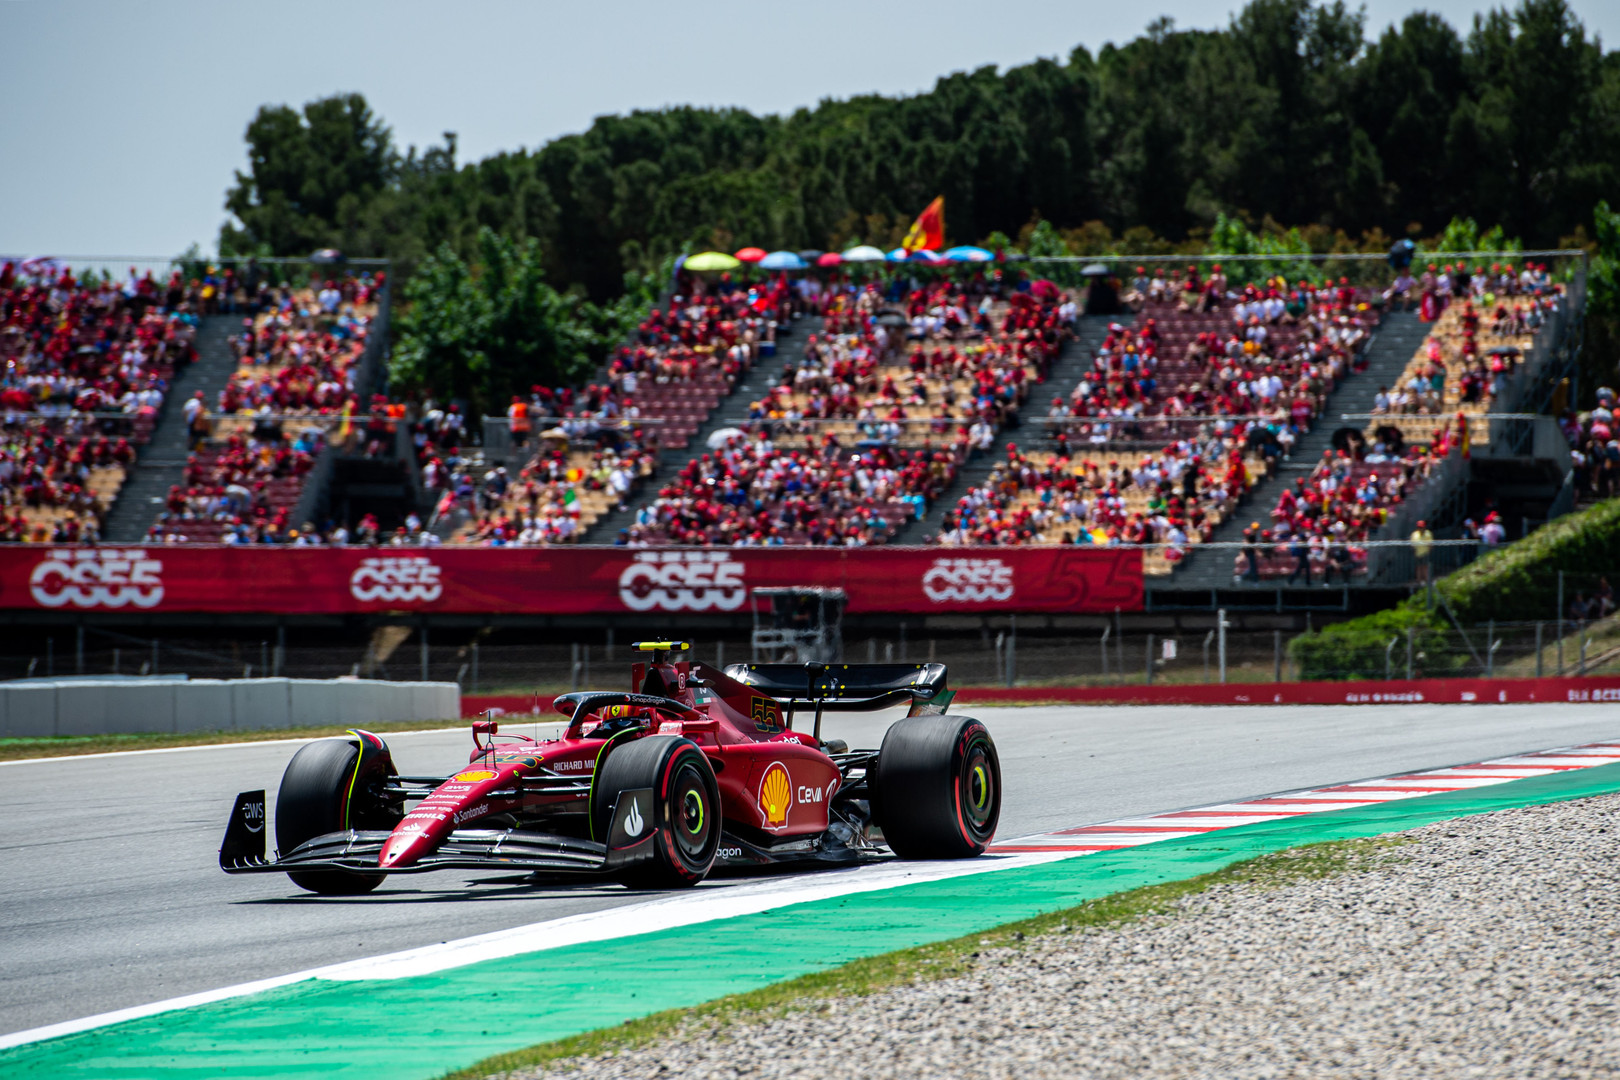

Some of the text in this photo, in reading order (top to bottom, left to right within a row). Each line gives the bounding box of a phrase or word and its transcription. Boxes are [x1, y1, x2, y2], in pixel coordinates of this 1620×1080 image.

[631, 695, 666, 705] Snapdragon
[751, 695, 781, 734] 55
[553, 759, 597, 772] RICHARD MIL
[458, 803, 490, 822] Santander
